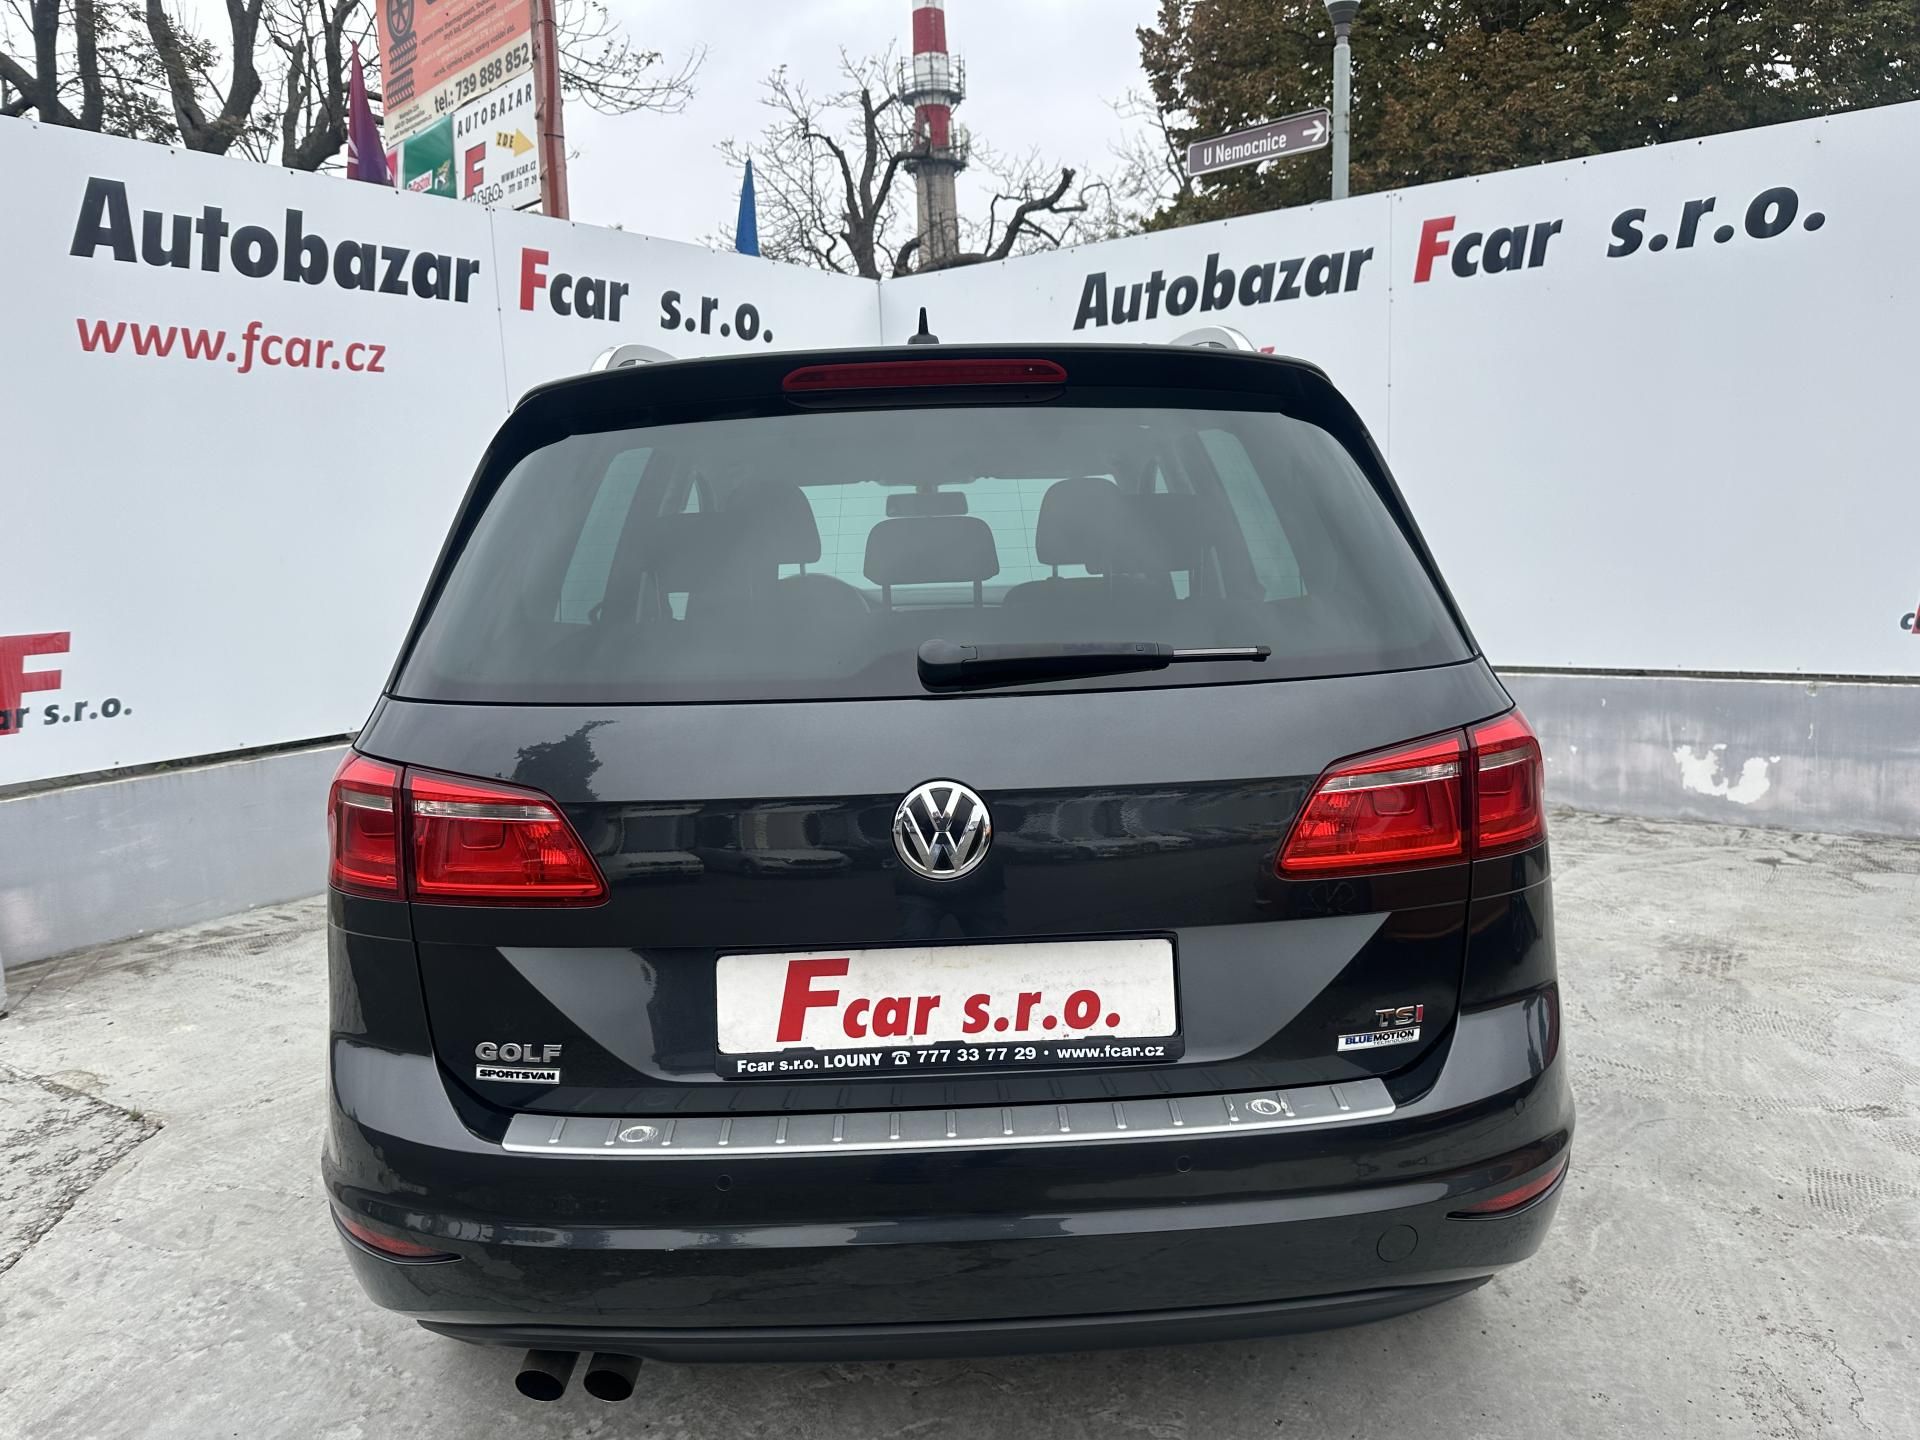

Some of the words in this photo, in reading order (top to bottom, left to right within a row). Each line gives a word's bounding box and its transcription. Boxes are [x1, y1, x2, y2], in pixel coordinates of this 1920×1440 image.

[434, 87, 454, 113] tel.:
[455, 72, 477, 101] 739
[479, 57, 504, 88] 888
[505, 42, 530, 73] 852
[456, 83, 532, 138] AUTOBAZAR
[496, 132, 514, 148] ZDE
[1203, 147, 1213, 166] U
[1215, 132, 1287, 164] Nemocnice
[69, 176, 481, 303] Autobazar
[520, 247, 629, 322] Fcar
[660, 291, 773, 343] s.r.o.
[1073, 248, 1374, 331] Autobazar
[1414, 216, 1562, 284] Fcar
[1606, 187, 1826, 258] s.r.o.
[77, 319, 386, 372] www.fcar.cz
[43, 697, 132, 726] s.r.o.
[776, 958, 941, 1043] Fcar
[962, 989, 1121, 1034] s.r.o.
[1375, 1004, 1424, 1028] TSI
[474, 1041, 563, 1063] GOLF
[1344, 1030, 1415, 1045] BLUEMOTION
[736, 1059, 775, 1073] Fcar
[779, 1058, 819, 1071] s.r.o.
[823, 1052, 883, 1069] LOUNY
[916, 1049, 951, 1063] 777
[956, 1048, 980, 1062] 33
[985, 1047, 1008, 1061] 77
[1014, 1046, 1037, 1060] 29
[1056, 1044, 1165, 1060] www.fcar.cz
[479, 1068, 556, 1081] SPORTSVAN
